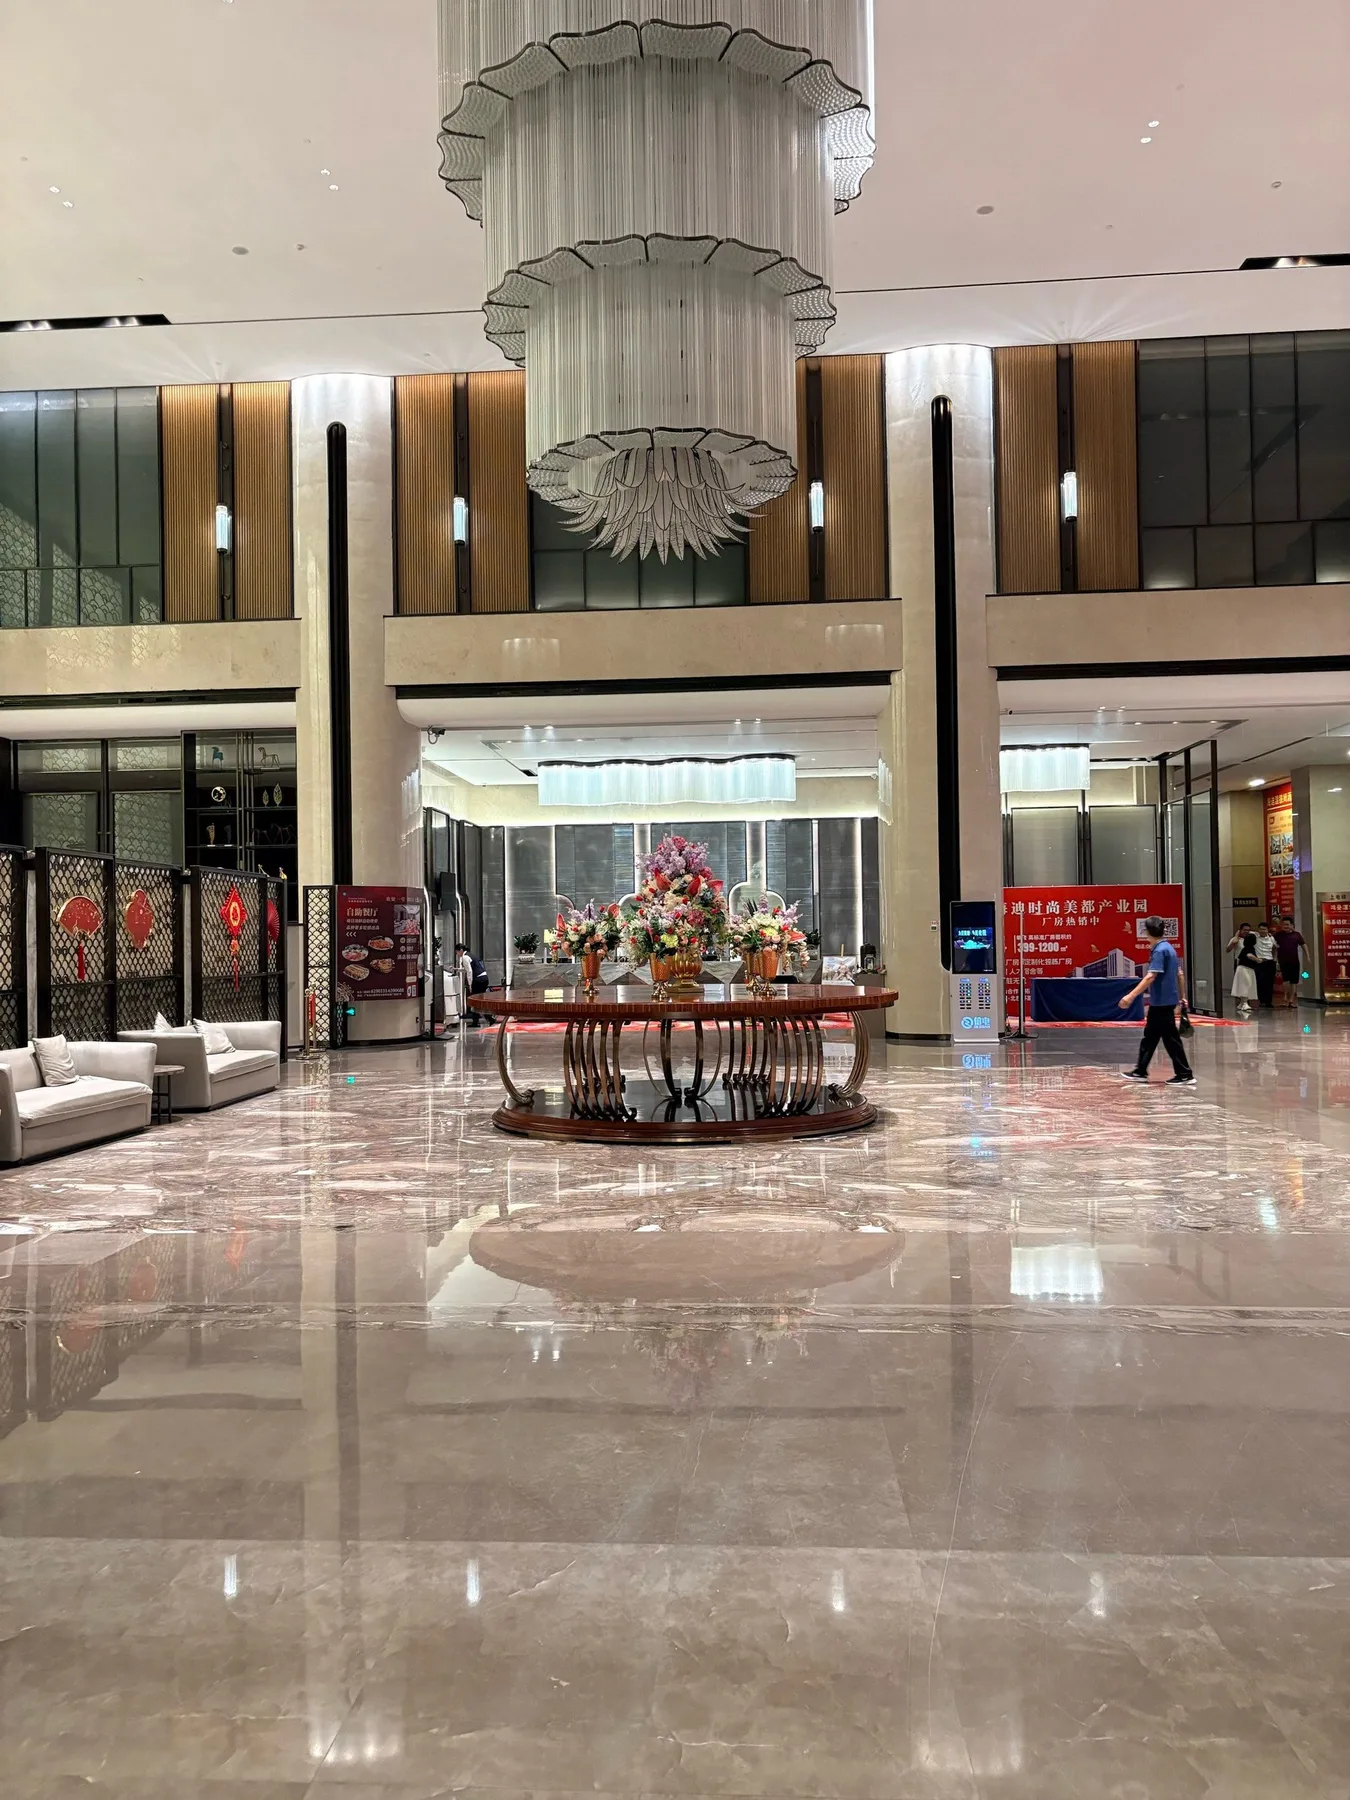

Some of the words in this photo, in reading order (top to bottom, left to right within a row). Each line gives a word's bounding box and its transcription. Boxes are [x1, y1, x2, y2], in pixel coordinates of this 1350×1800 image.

[1042, 916, 1099, 926] 厂房热销中
